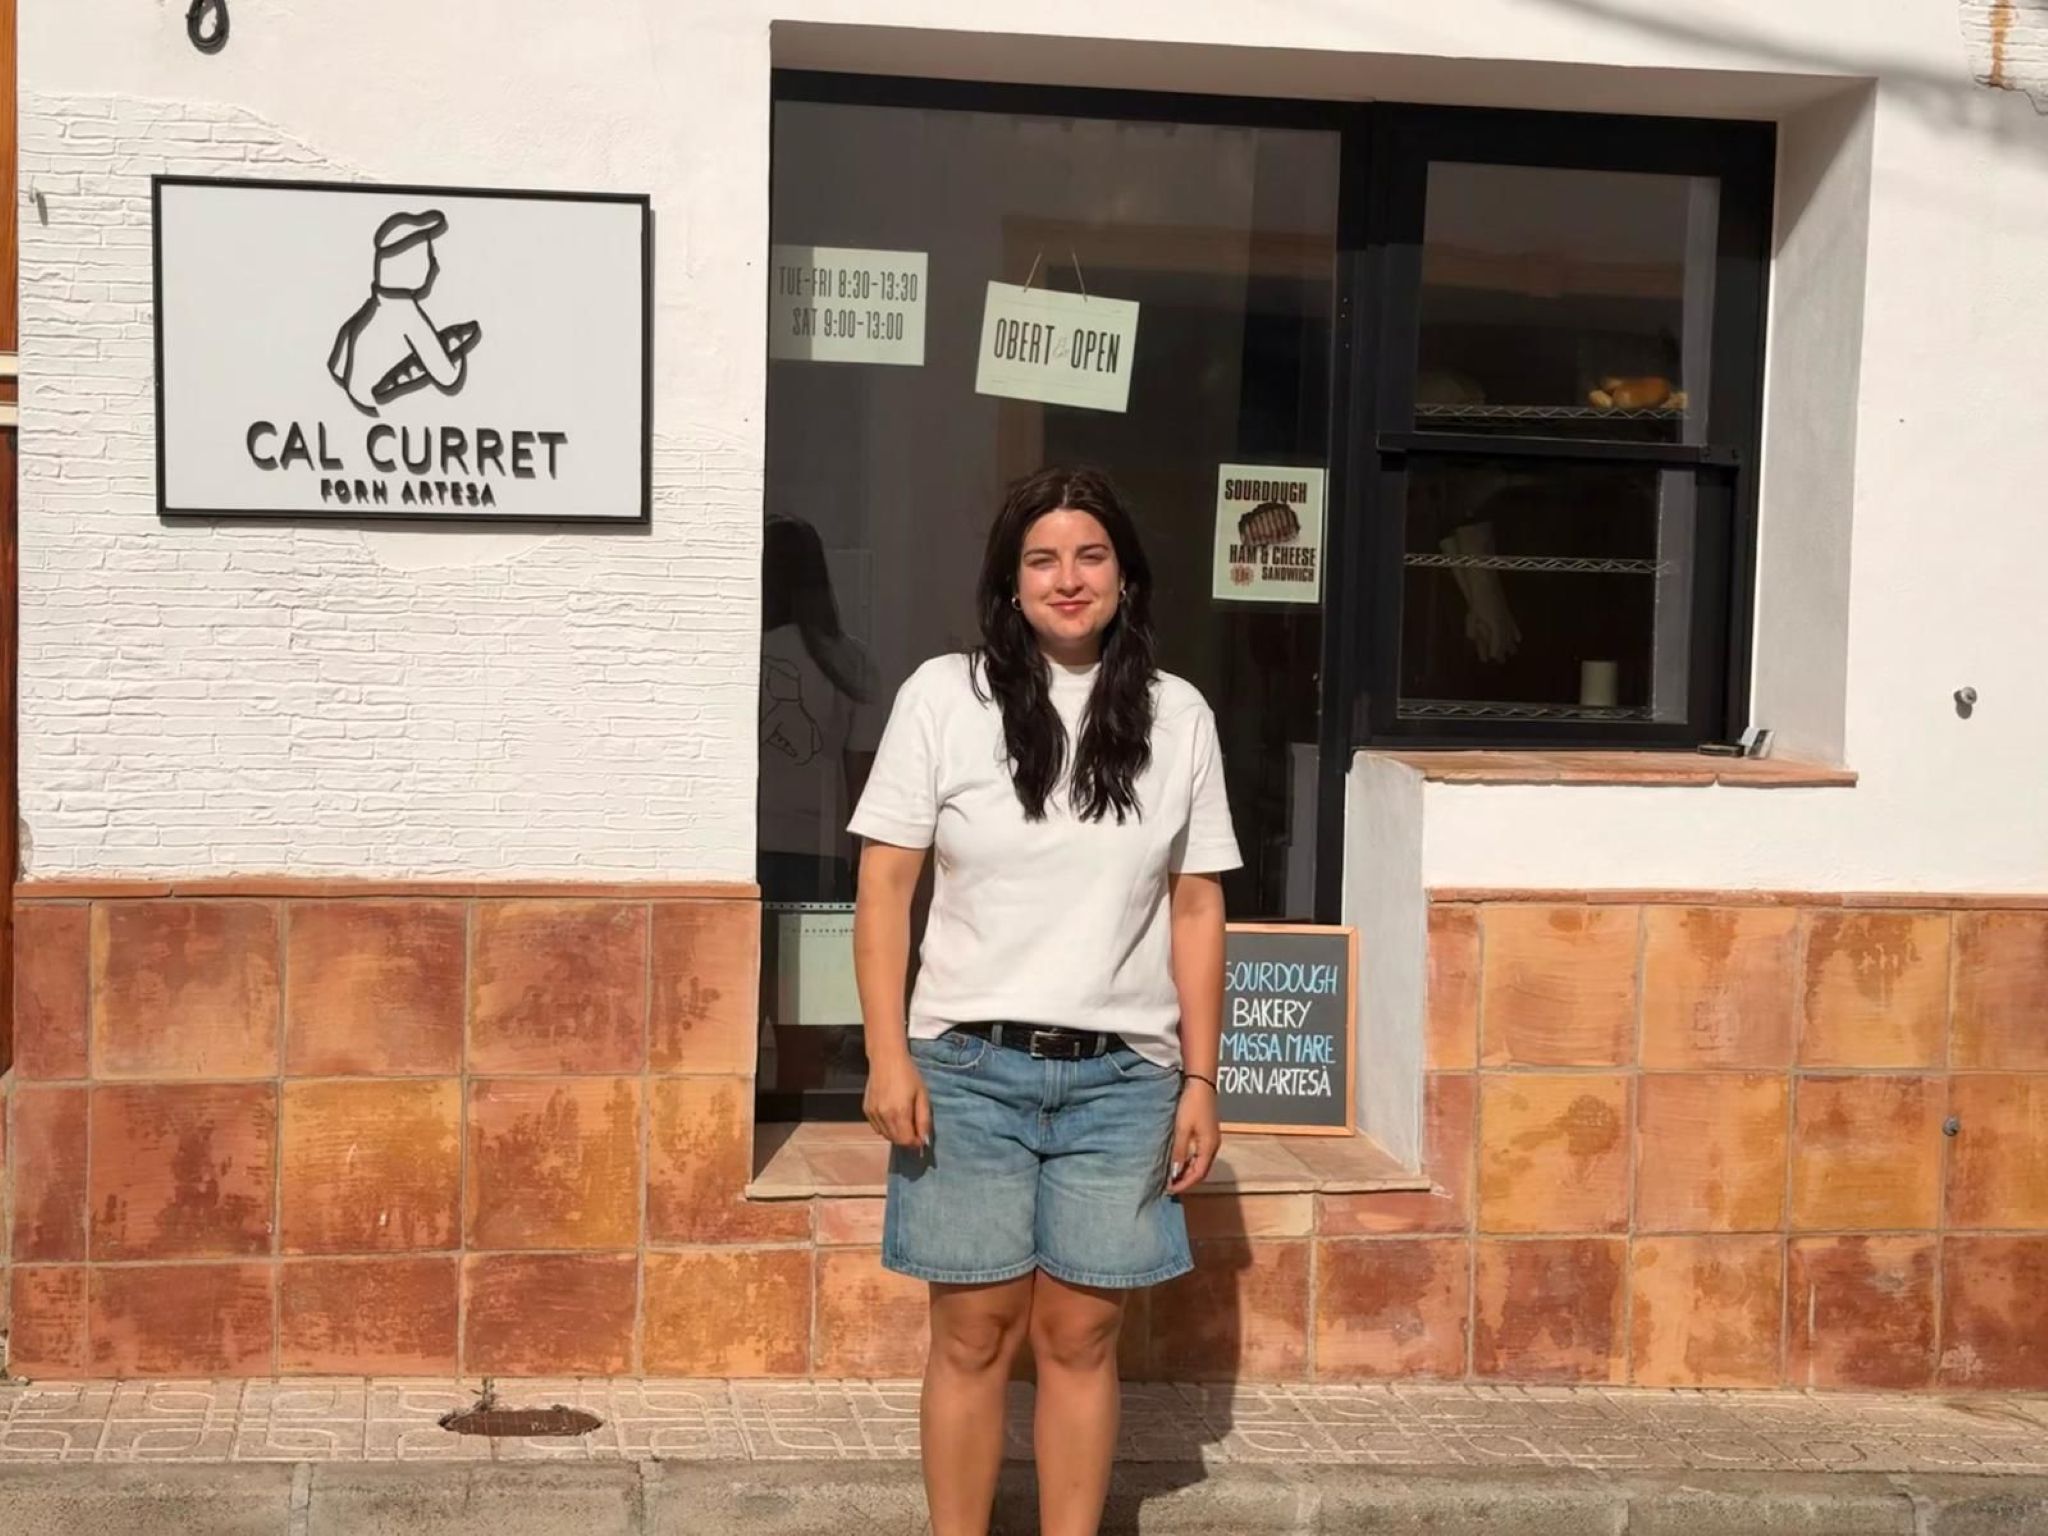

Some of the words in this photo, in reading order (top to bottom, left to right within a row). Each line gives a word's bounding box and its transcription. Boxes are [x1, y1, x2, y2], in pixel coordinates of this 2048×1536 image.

[779, 266, 832, 295] TUE-FRI
[838, 269, 918, 302] 8:30-13:30
[793, 308, 817, 336] SAT
[824, 310, 904, 340] 9:00-13:00
[994, 317, 1055, 365] OBERT
[1071, 328, 1120, 374] OPEN
[246, 420, 344, 471] CAL
[366, 423, 569, 479] CURRET
[320, 478, 388, 504] FORN
[401, 480, 496, 507] ARTESA
[1225, 479, 1307, 504] SOURDOUGH
[1229, 544, 1256, 564] HAM
[1272, 545, 1316, 567] CHEESE
[1262, 566, 1315, 583] SANDWICH
[1225, 961, 1338, 996] SOURDOUGH
[1232, 997, 1313, 1028] BAKERY
[1218, 1032, 1282, 1063] MASSA
[1285, 1034, 1336, 1064] MARE
[1216, 1066, 1264, 1095] FORN
[1265, 1065, 1332, 1097] ARTESÀ
